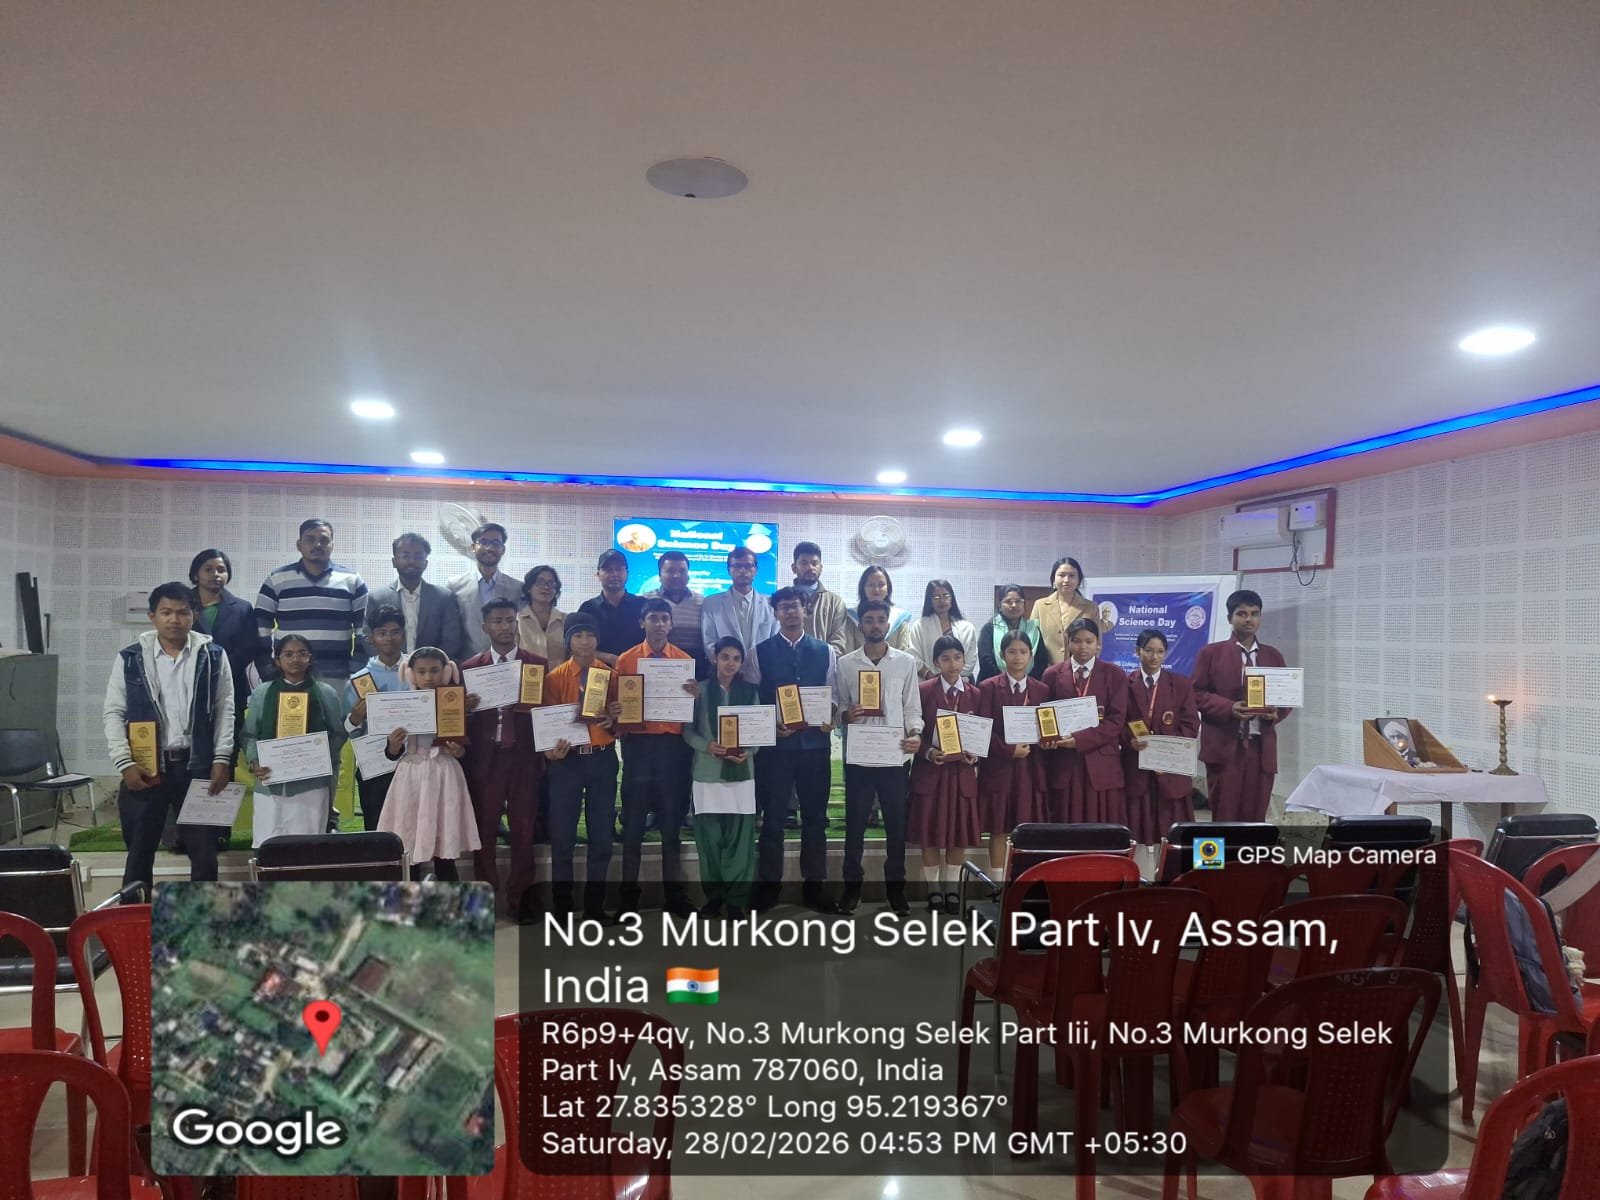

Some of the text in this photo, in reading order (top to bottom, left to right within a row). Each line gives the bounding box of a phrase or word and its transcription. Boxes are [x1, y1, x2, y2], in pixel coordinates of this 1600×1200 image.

[1128, 605, 1168, 614] National
[1119, 617, 1176, 629] Science Day
